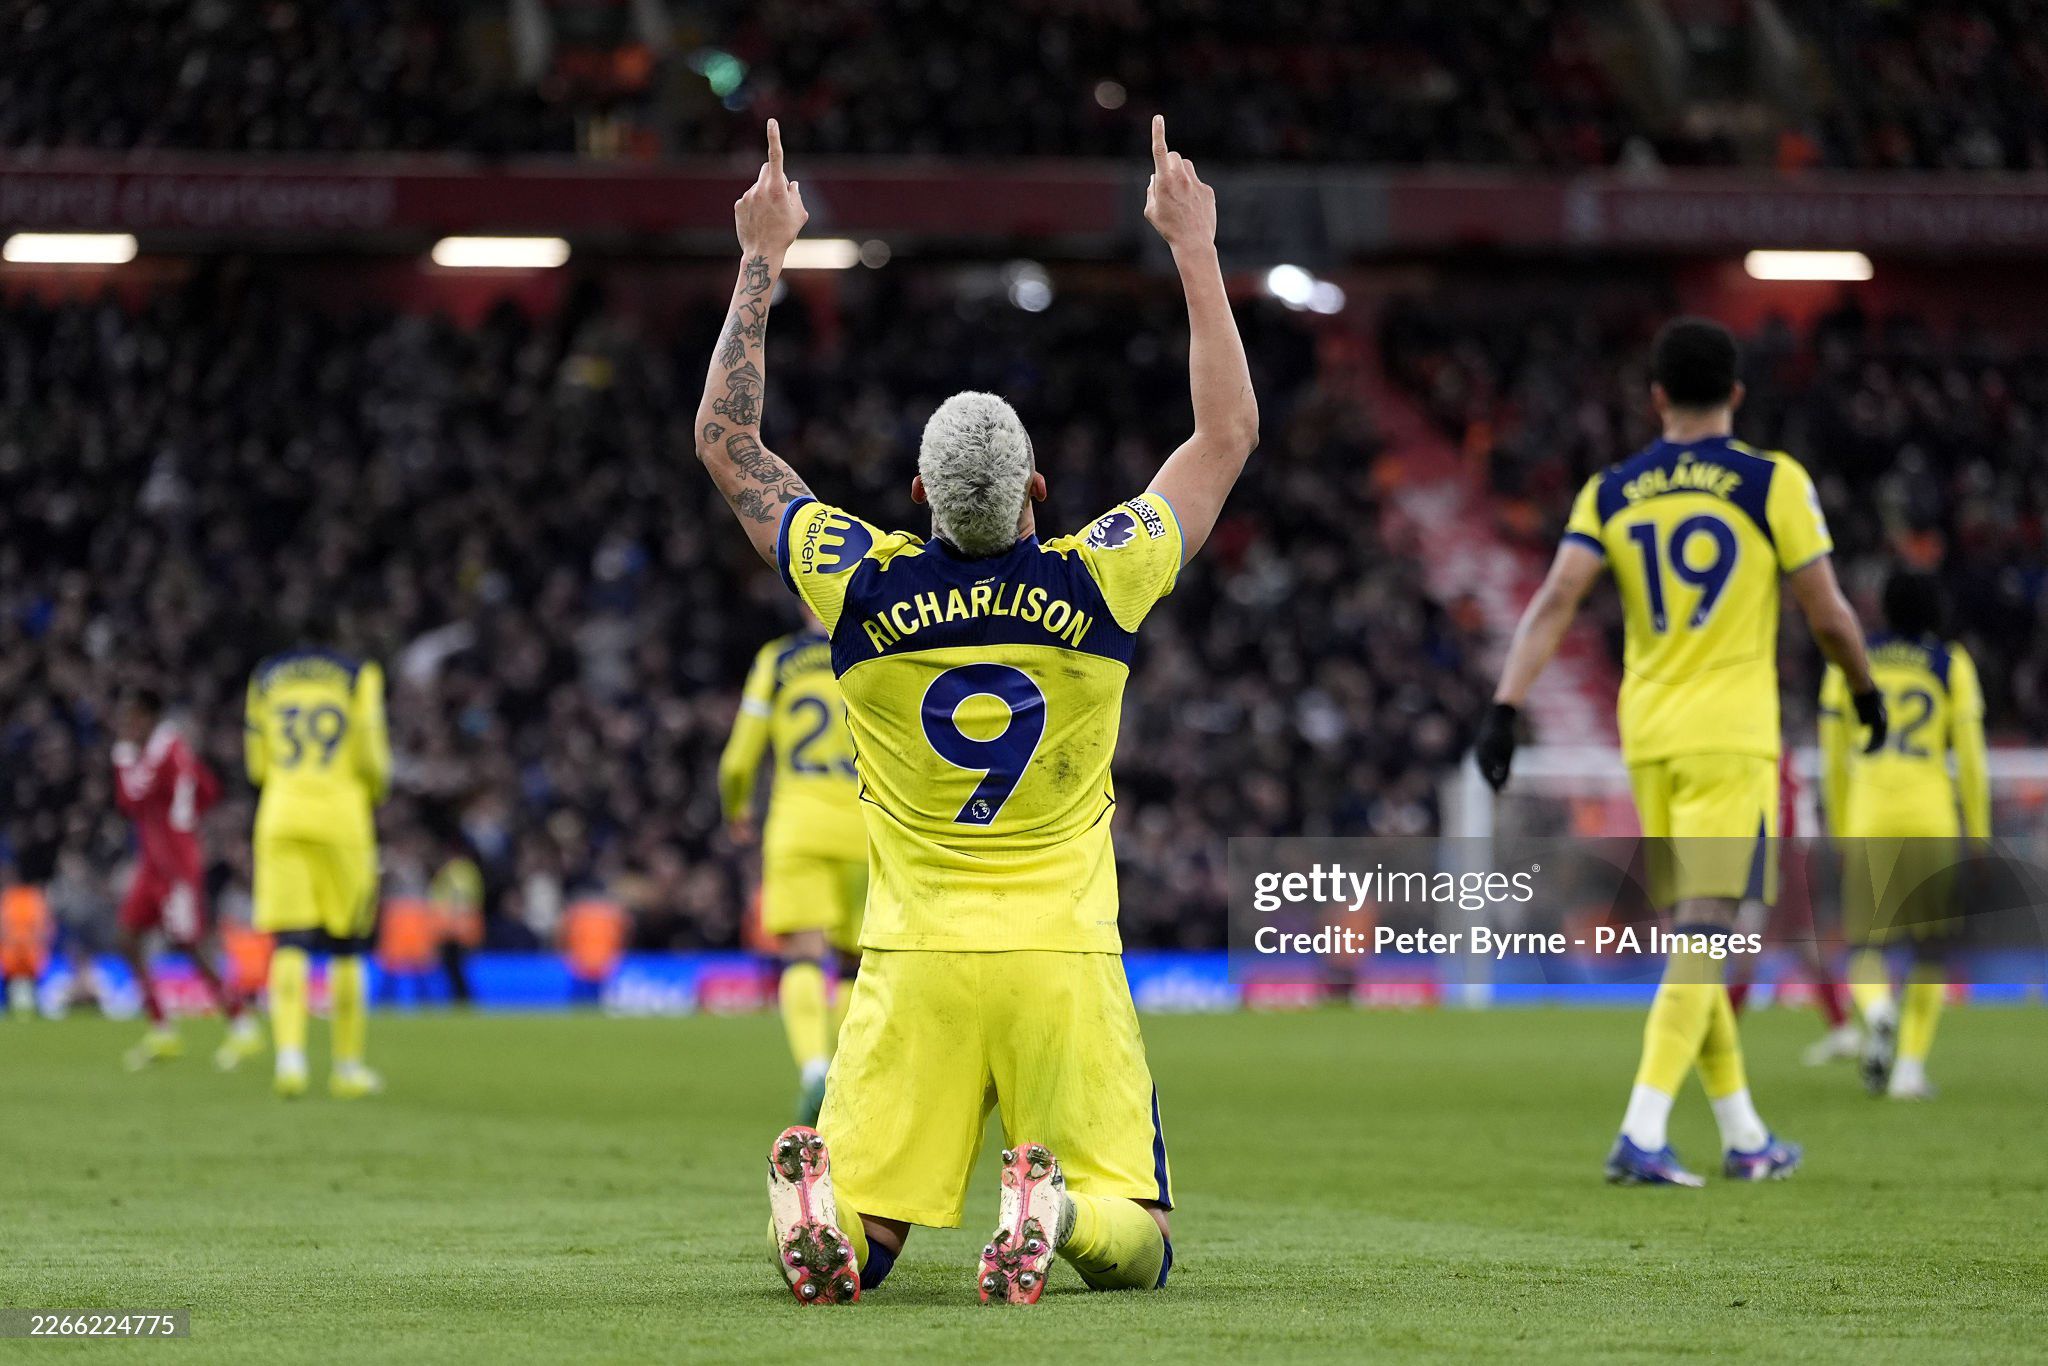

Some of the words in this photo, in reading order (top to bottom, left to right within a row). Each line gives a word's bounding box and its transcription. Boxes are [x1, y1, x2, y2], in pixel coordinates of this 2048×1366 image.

[801, 508, 831, 574] kraken
[1147, 520, 1159, 539] No
[1628, 514, 1738, 633] 19
[862, 582, 1093, 654] RICHARLISON
[278, 705, 348, 769] 39
[788, 696, 858, 778] 2
[920, 662, 1047, 826] 9
[1881, 687, 1935, 757] 2
